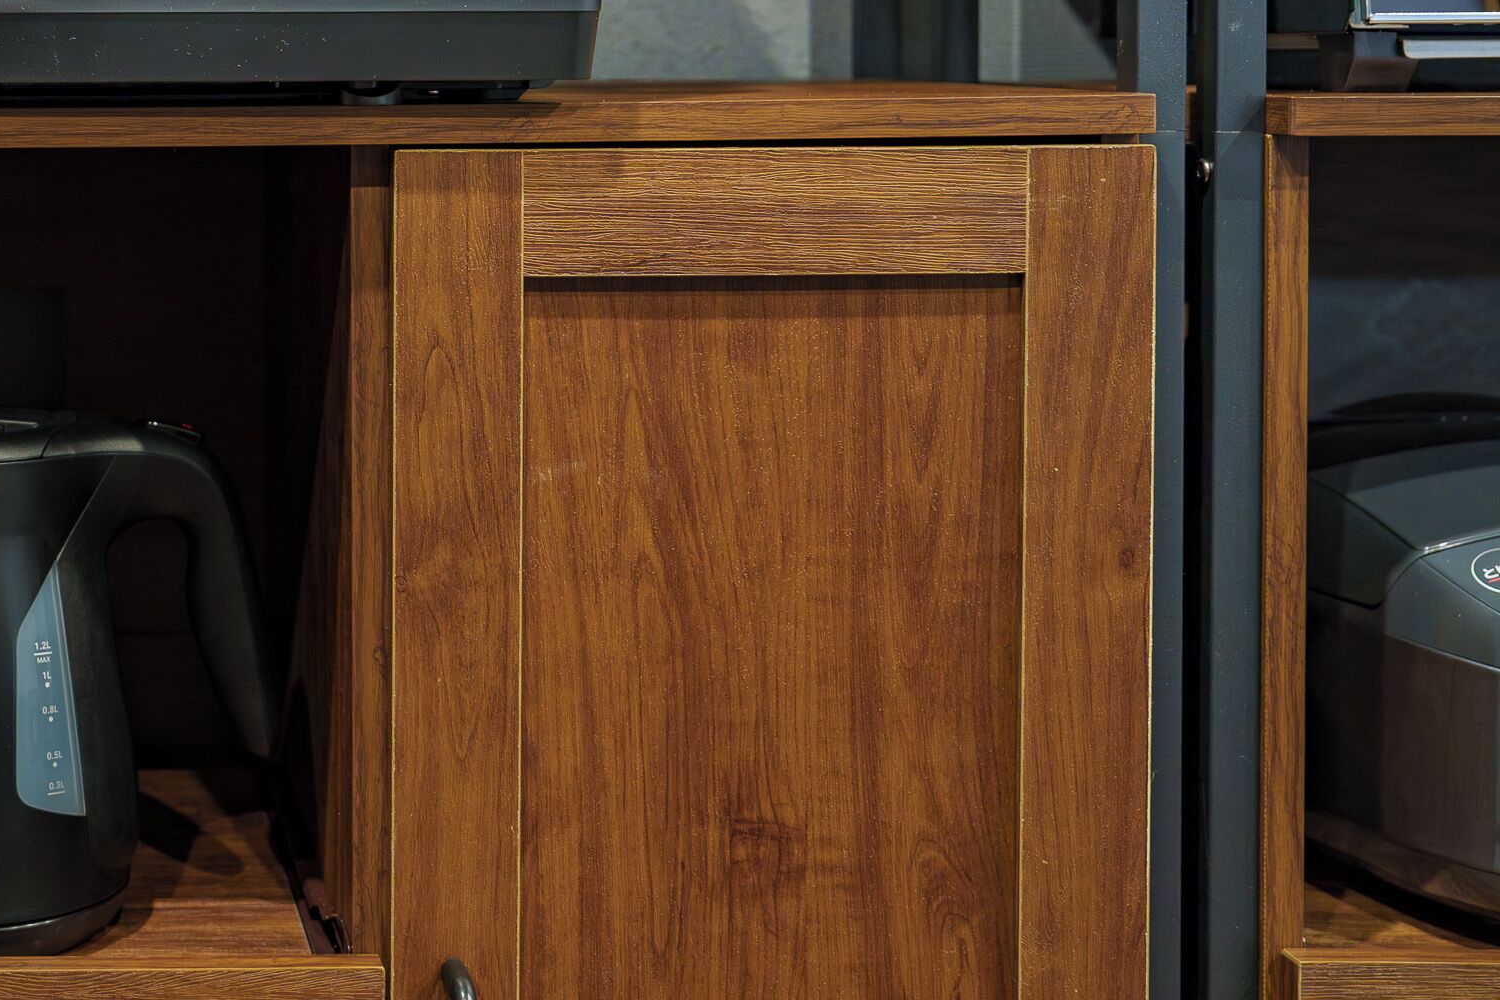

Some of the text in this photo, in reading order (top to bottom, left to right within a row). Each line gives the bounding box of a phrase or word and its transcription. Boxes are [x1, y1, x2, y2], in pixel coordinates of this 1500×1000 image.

[34, 640, 52, 651] 1.2L
[36, 655, 51, 664] MAX
[42, 671, 53, 680] 1L
[46, 750, 63, 760] 0.5L
